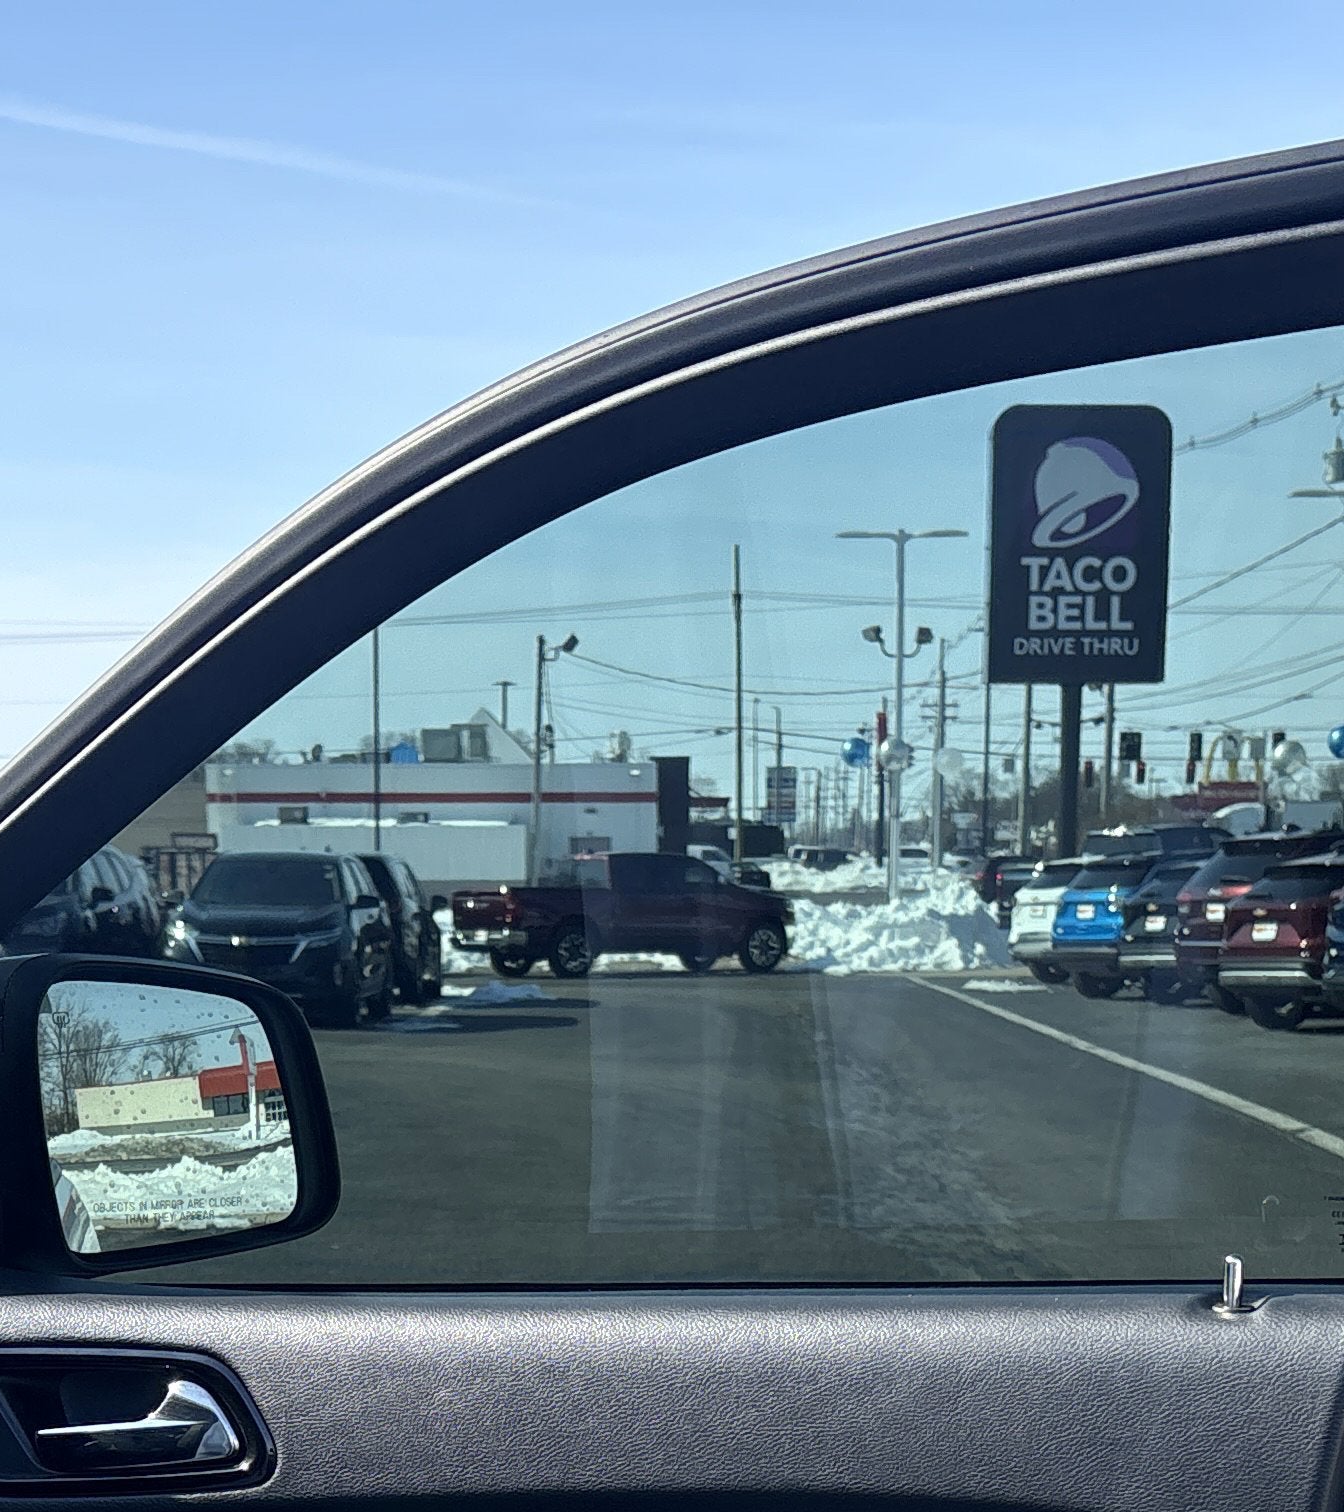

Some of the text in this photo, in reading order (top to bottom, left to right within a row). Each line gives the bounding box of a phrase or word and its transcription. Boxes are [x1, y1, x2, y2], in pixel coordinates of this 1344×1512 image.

[1020, 557, 1137, 593] TACO
[1027, 595, 1135, 631] BELL
[1013, 637, 1139, 656] DRIVE THRU
[92, 1195, 243, 1214] OBJECTS IN MIRROR ARE CLOSER
[124, 1209, 215, 1225] THAN THEY APPEAR
